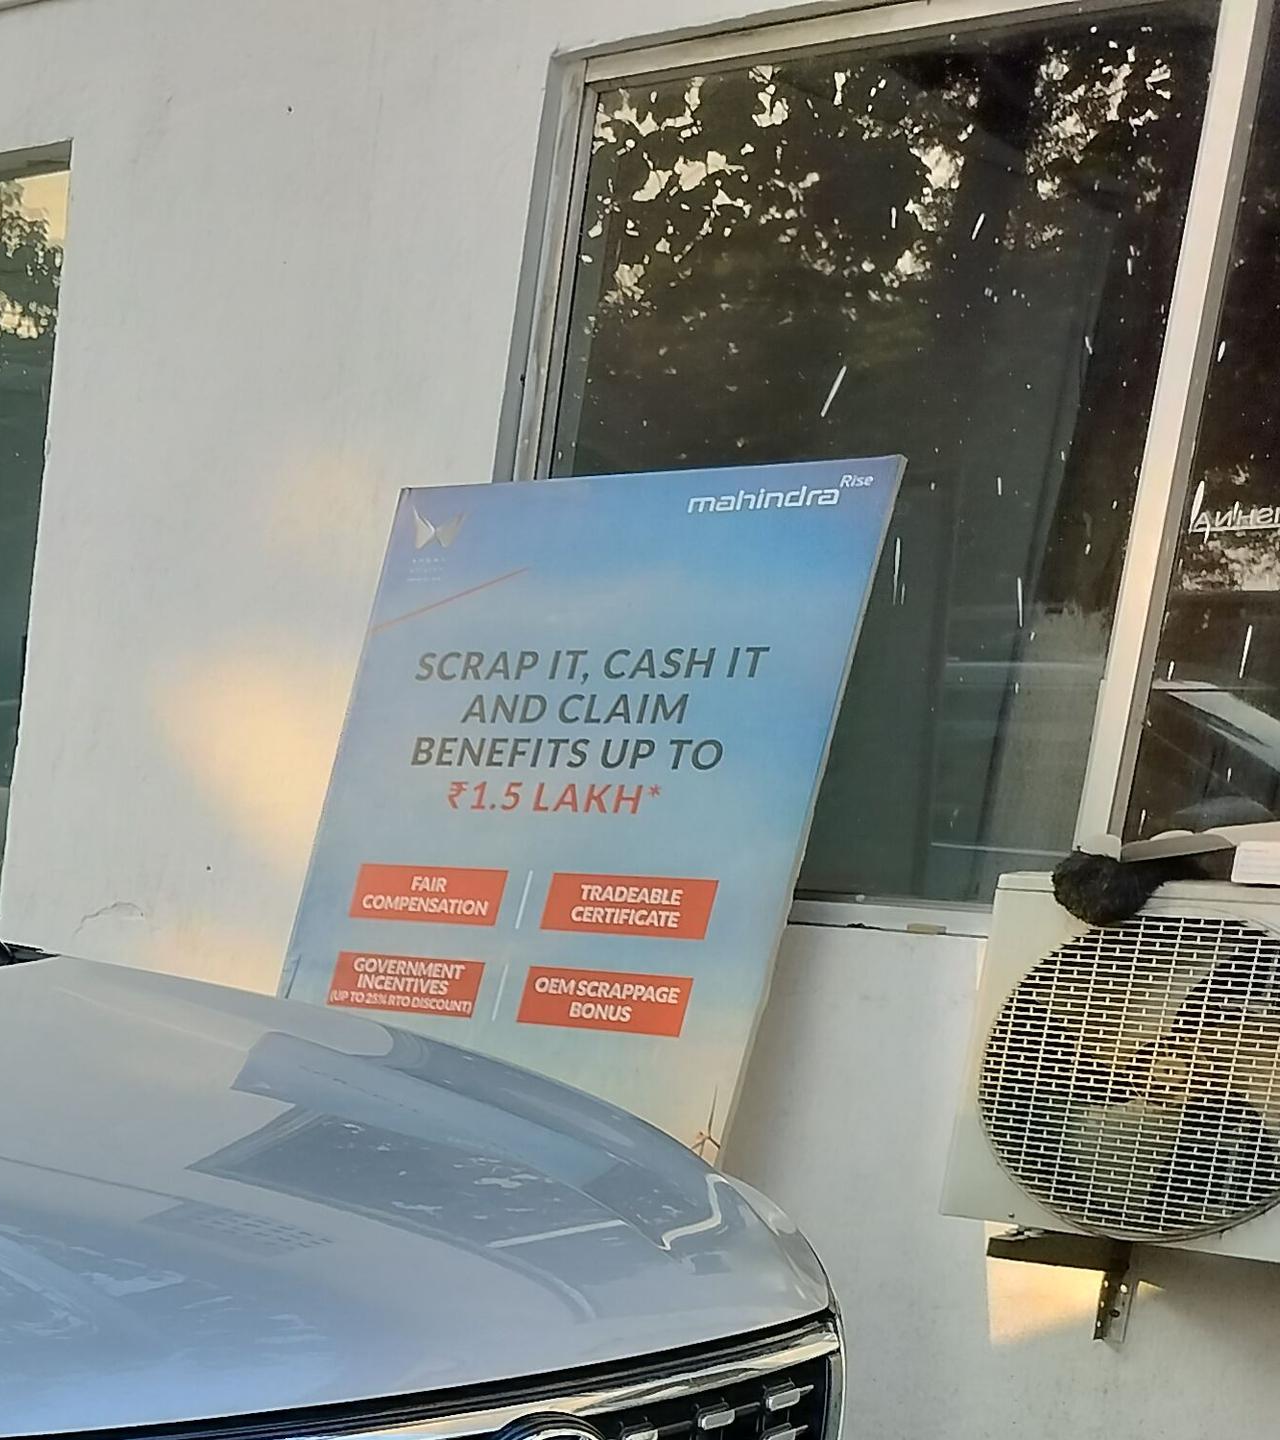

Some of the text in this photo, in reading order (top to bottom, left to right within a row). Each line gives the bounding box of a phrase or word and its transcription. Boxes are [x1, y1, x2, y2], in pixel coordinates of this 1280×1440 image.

[687, 474, 874, 514] mahindra Rise
[415, 646, 771, 685] SCRAP IT, CASH IT
[461, 692, 689, 725] AND CLAIM
[411, 736, 724, 771] BENEFITS UP TO
[447, 781, 523, 811] ₹1.5
[410, 876, 447, 893] FAIR
[581, 884, 684, 906] TRADEABLE
[362, 894, 489, 917] COMPENSATION
[571, 906, 681, 928] CERTIFICATE
[353, 957, 466, 980] GOVERNMENT
[357, 973, 450, 996] INCENTIVES
[534, 977, 682, 1004] OEM SCRAPPAGE
[350, 991, 365, 1003] TO
[387, 994, 409, 1007] RTO
[411, 996, 473, 1014] DISCOUNT)
[569, 1001, 633, 1022] BONUS
